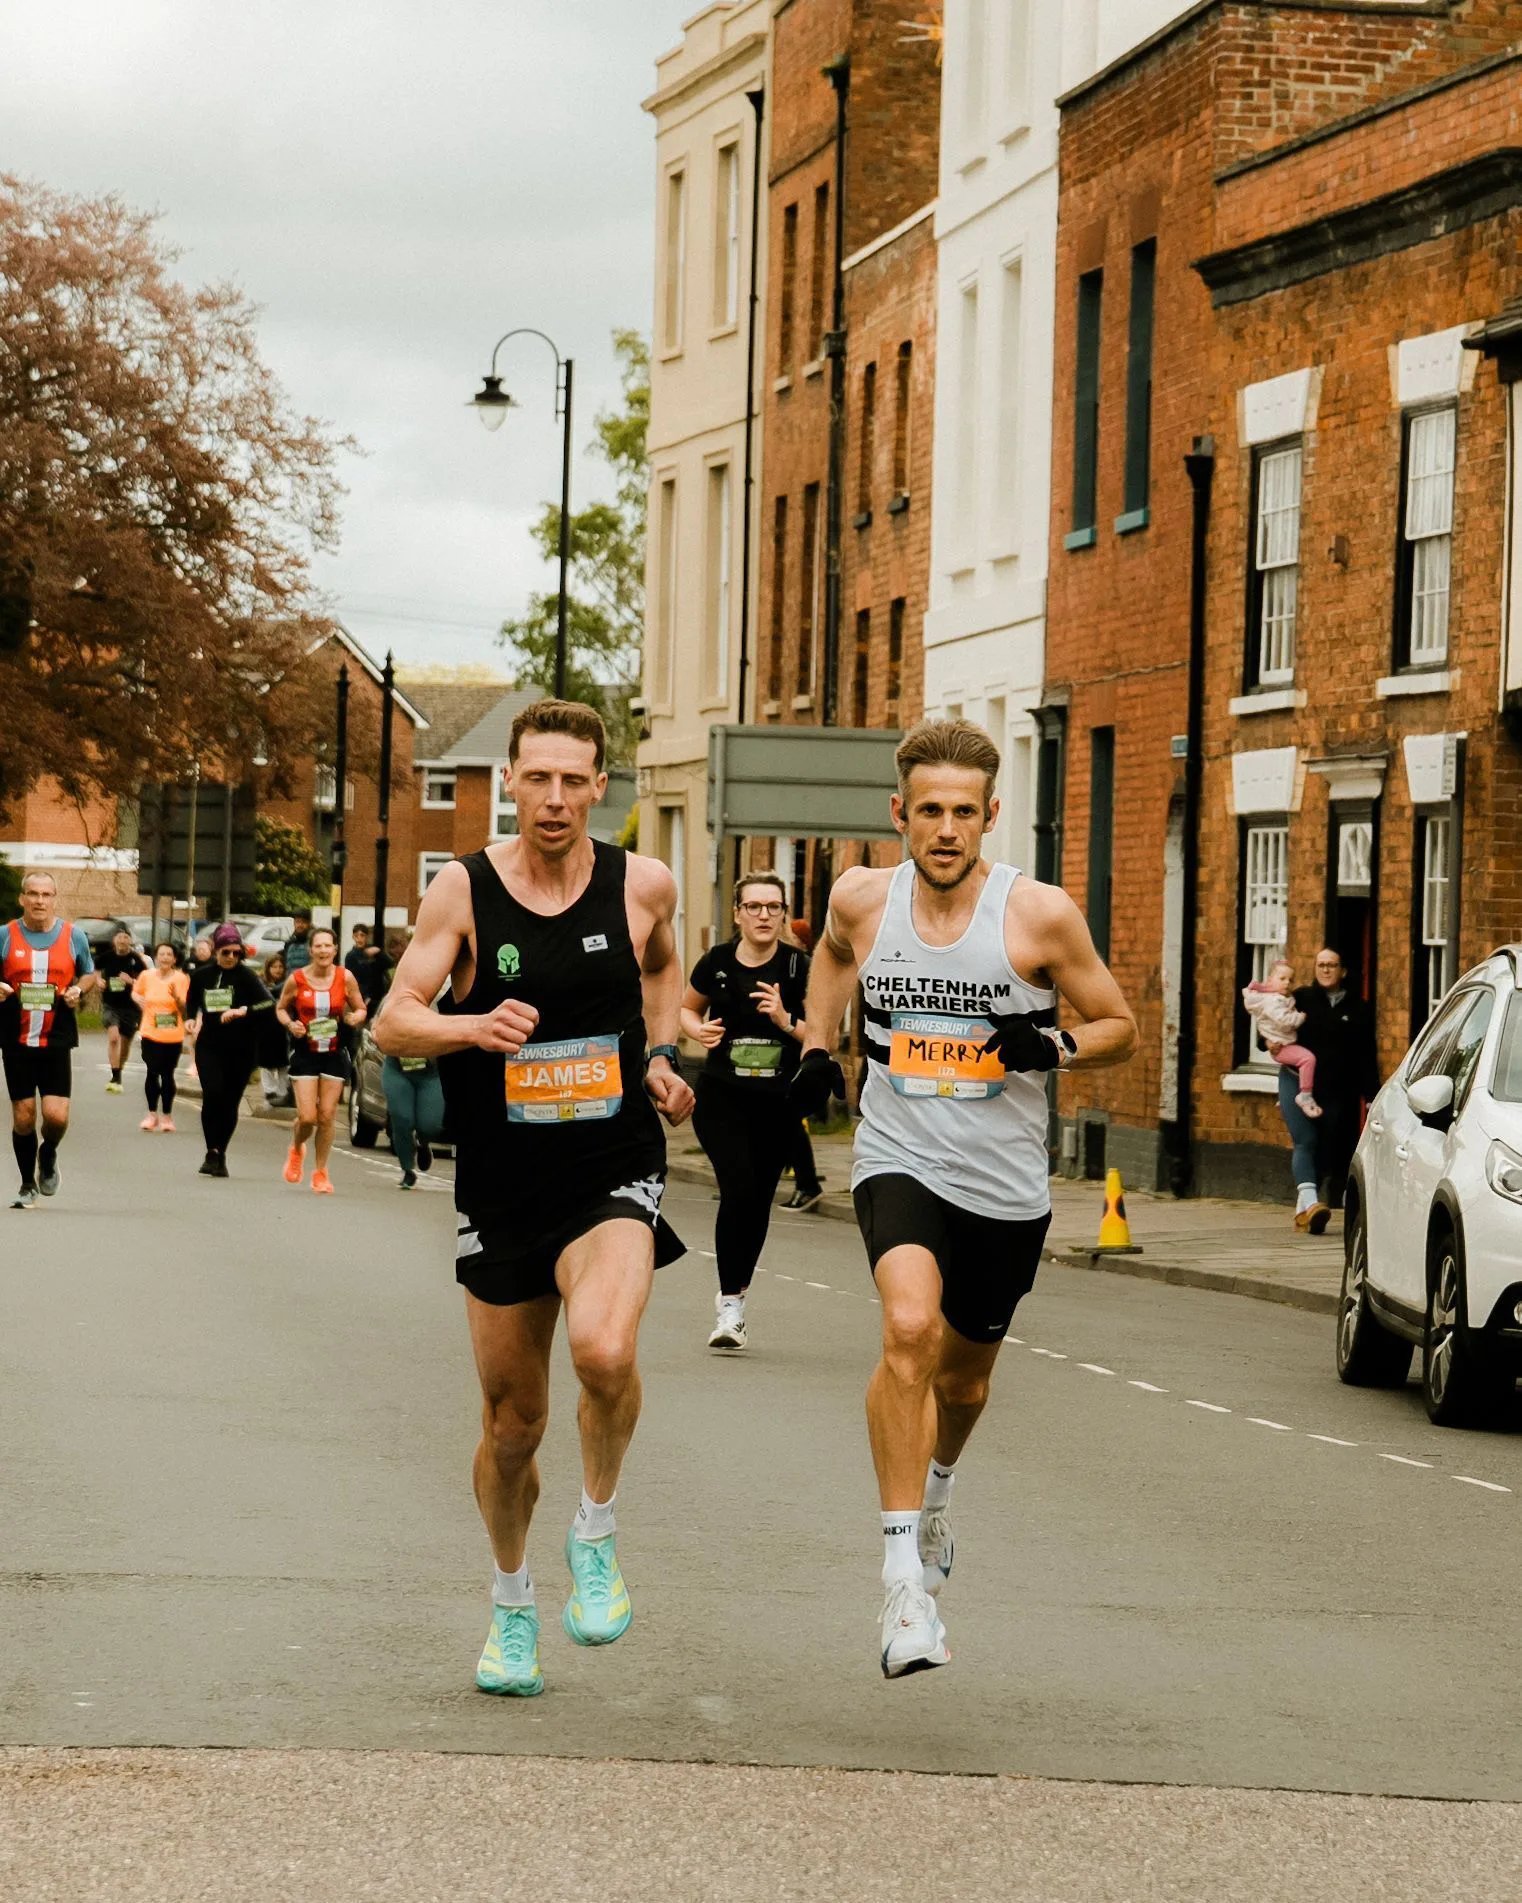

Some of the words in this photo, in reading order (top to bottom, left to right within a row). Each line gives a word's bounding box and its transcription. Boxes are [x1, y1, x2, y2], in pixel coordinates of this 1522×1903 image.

[866, 975, 1010, 999] CHELTENHAM
[880, 994, 992, 1013] HARRIERS
[899, 1017, 971, 1035] TEWKESBURY
[908, 1037, 986, 1063] MERRY
[519, 1061, 607, 1087] JAMES
